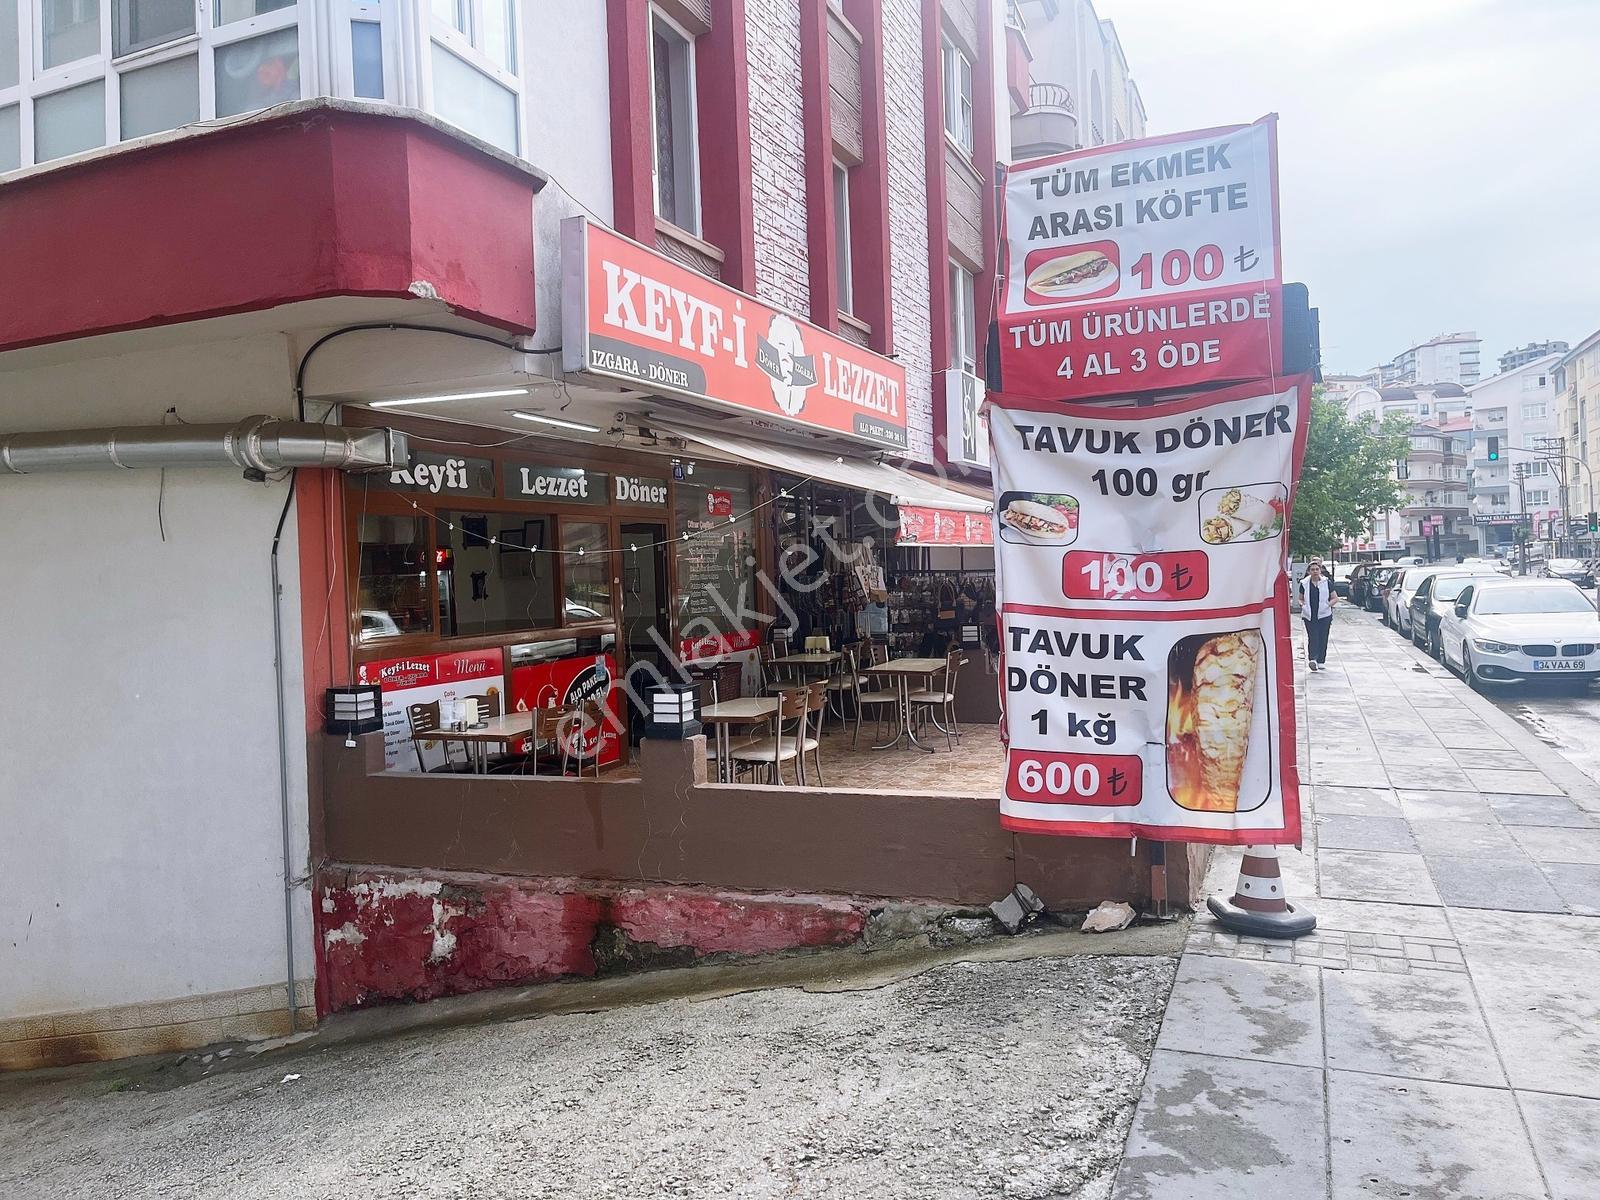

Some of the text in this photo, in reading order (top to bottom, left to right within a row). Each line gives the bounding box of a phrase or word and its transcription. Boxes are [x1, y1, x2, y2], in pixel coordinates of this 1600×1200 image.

[1030, 143, 1232, 201] TÜM EKMEK
[1027, 182, 1248, 241] ARASI KÖFTE
[1130, 243, 1225, 290] 100
[602, 260, 748, 369] KEYF-İ
[822, 352, 899, 418] LEZZET
[1009, 293, 1272, 350] TÜM ÜRÜNLERDE
[591, 349, 641, 377] IZGARA
[648, 361, 689, 388] DÖNER
[1056, 339, 1221, 380] 4 AL 3 ÖDE
[1014, 404, 1292, 455] TAVUK DÖNER
[520, 467, 588, 498] Lezzet
[615, 475, 668, 504] Döner
[1091, 467, 1210, 502] 100 gr
[1081, 560, 1164, 594] 100
[1008, 626, 1145, 662] TAVUK
[380, 659, 487, 679] Keyf-i Lezzet Menü
[582, 673, 597, 694] PAKE
[1007, 664, 1148, 701] DÖNER
[1539, 661, 1584, 670] 34 VAA 69
[1030, 708, 1118, 746] 1 kğ
[1017, 759, 1100, 797] 600
